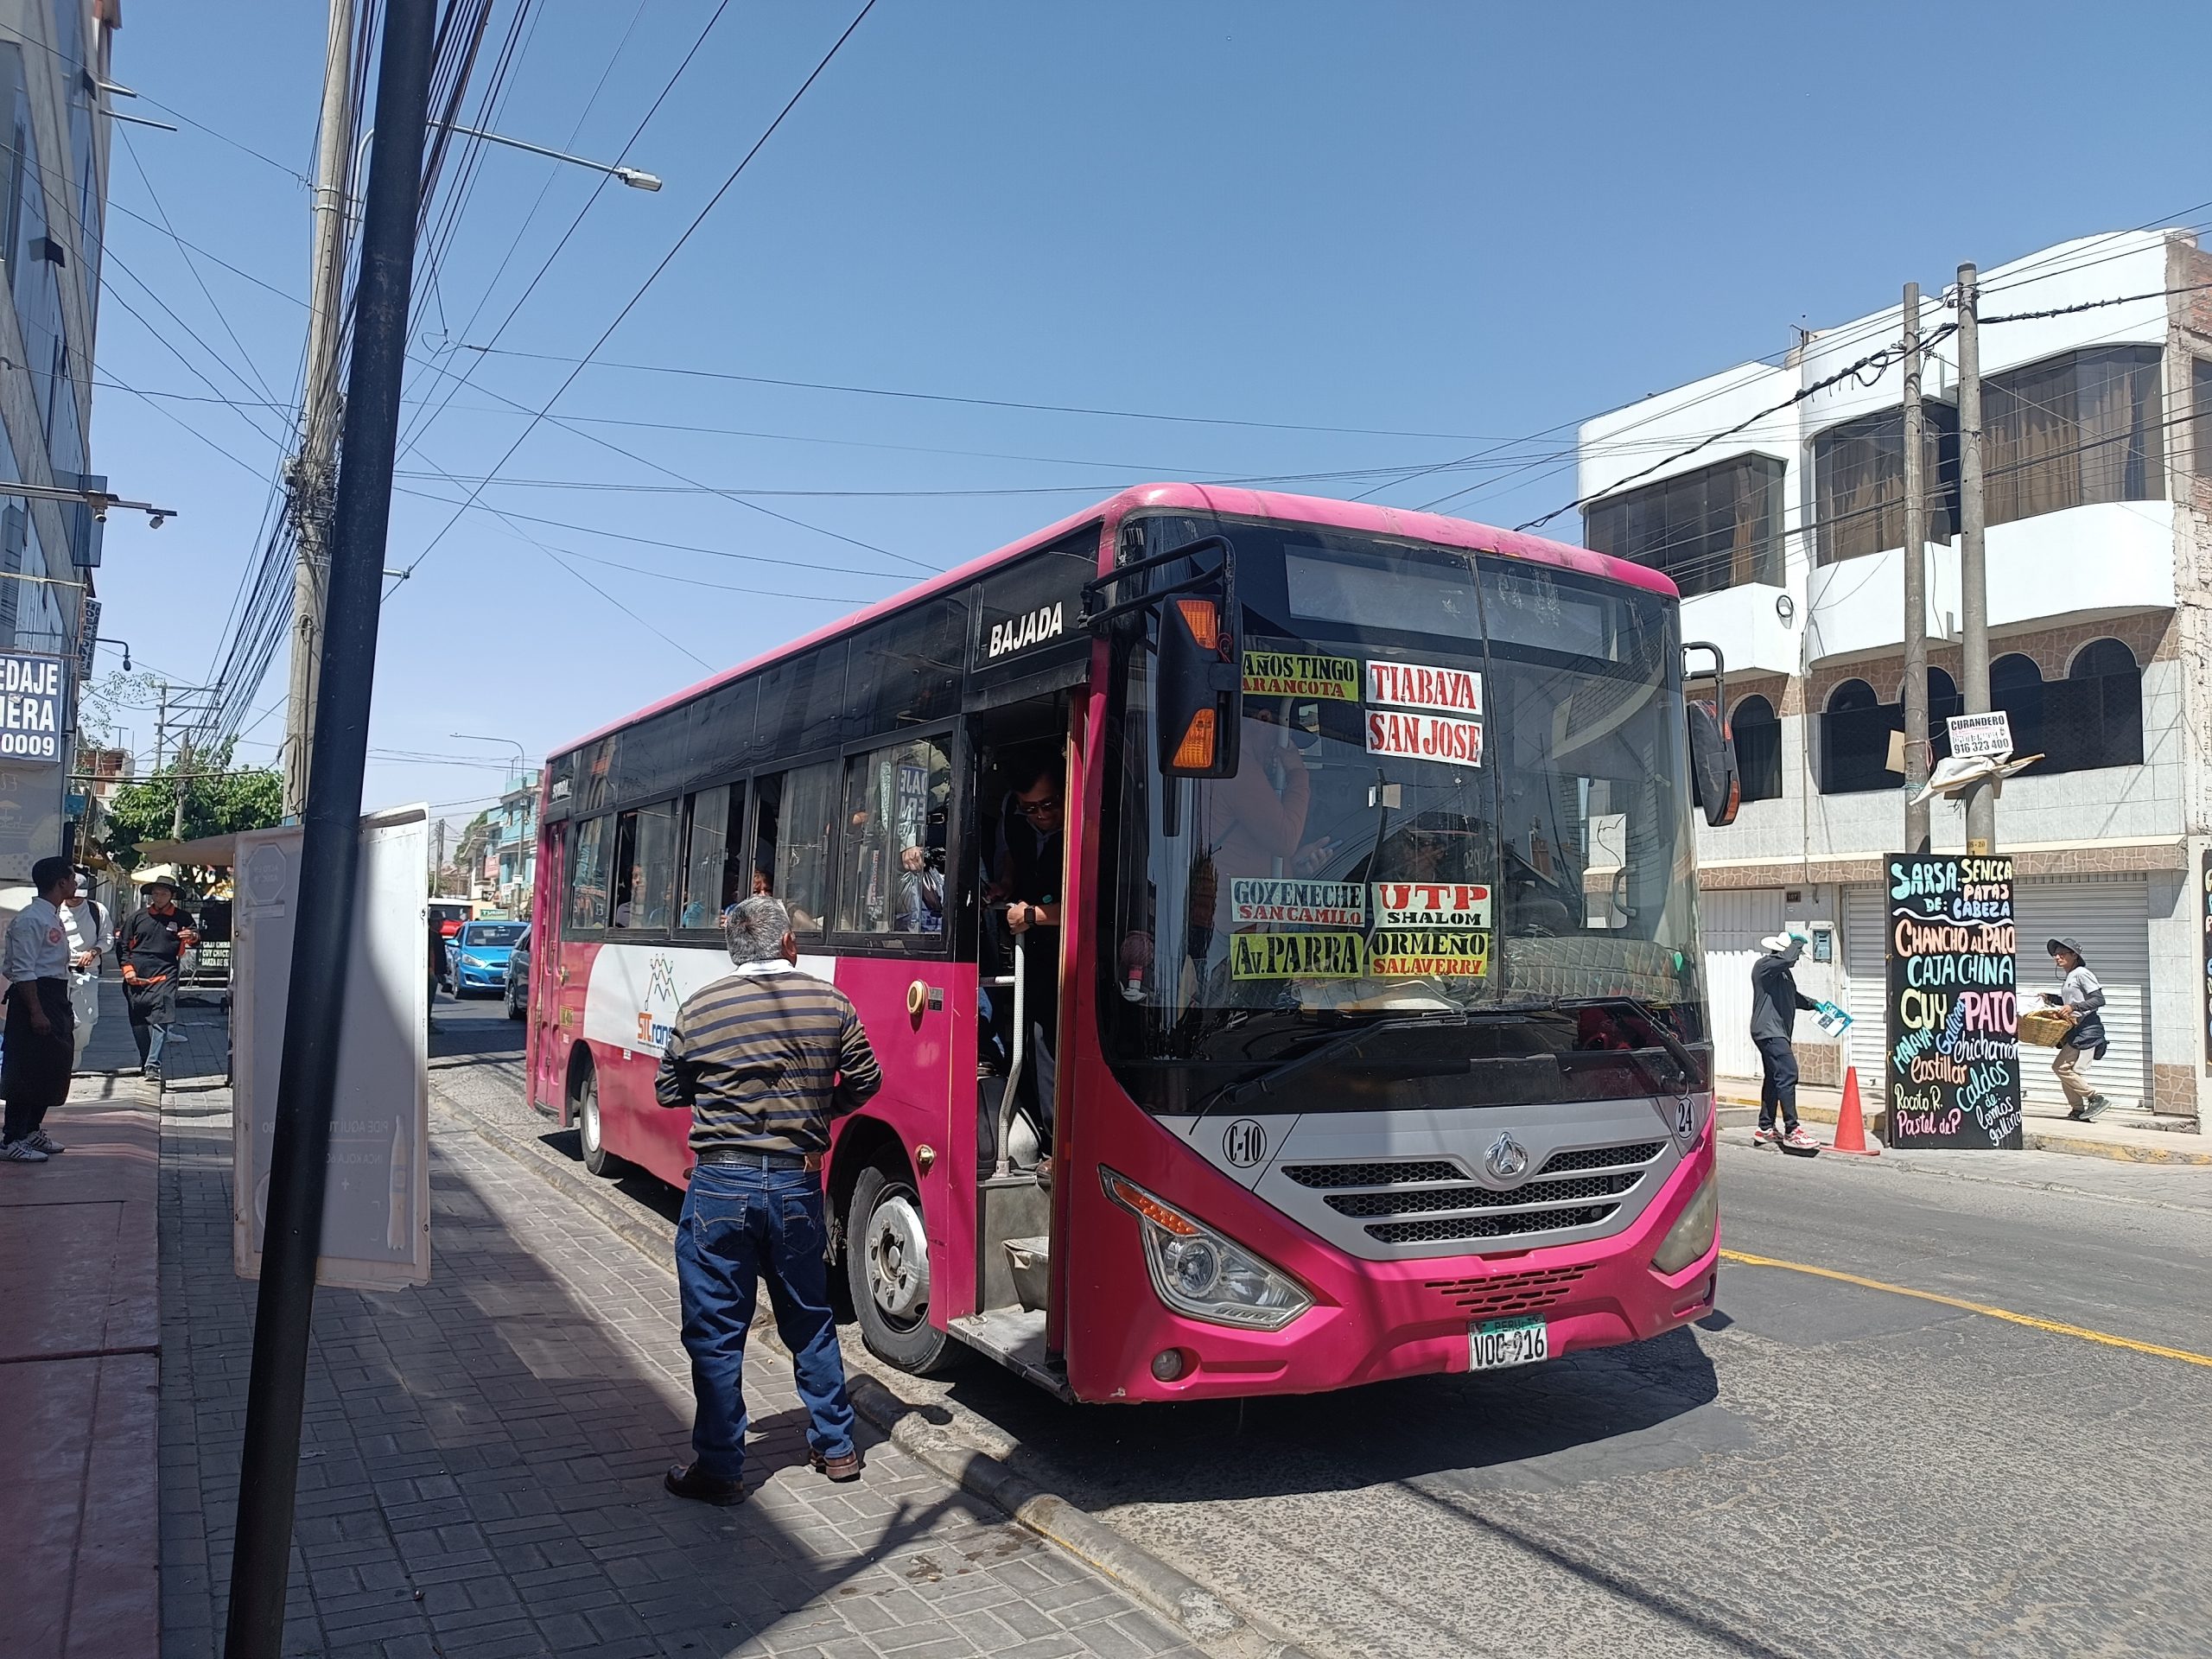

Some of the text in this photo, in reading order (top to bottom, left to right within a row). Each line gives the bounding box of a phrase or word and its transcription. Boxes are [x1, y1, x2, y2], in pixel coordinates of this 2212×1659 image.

[988, 601, 1063, 658] BAJADA
[1297, 657, 1355, 682] TINGO
[1370, 664, 1477, 709] TIABAYA
[1950, 715, 2005, 731] CURANDERO
[1370, 713, 1480, 762] SAN JOSE
[1954, 738, 2010, 754] 916 323 400
[1234, 880, 1362, 908] GOYENECHE
[1379, 884, 1488, 910] UTP
[1963, 883, 2010, 902] PATAS
[1388, 912, 1482, 925] SHALOM
[1953, 897, 2011, 919] CABEZA
[1372, 932, 1485, 956] ORMEÑO
[1895, 918, 1969, 957] CHANCHO
[1978, 925, 2016, 954] PALO
[1373, 957, 1484, 975] SALAVERRY
[1907, 955, 1955, 988] CAJA
[1900, 988, 2018, 1033] CUY PATO
[1892, 1026, 1935, 1074] MALAYA
[1894, 1083, 1929, 1111] Rocoto
[1678, 1102, 1692, 1132] 24
[1896, 1109, 1936, 1138] Pastel
[1229, 1125, 1262, 1161] C-10
